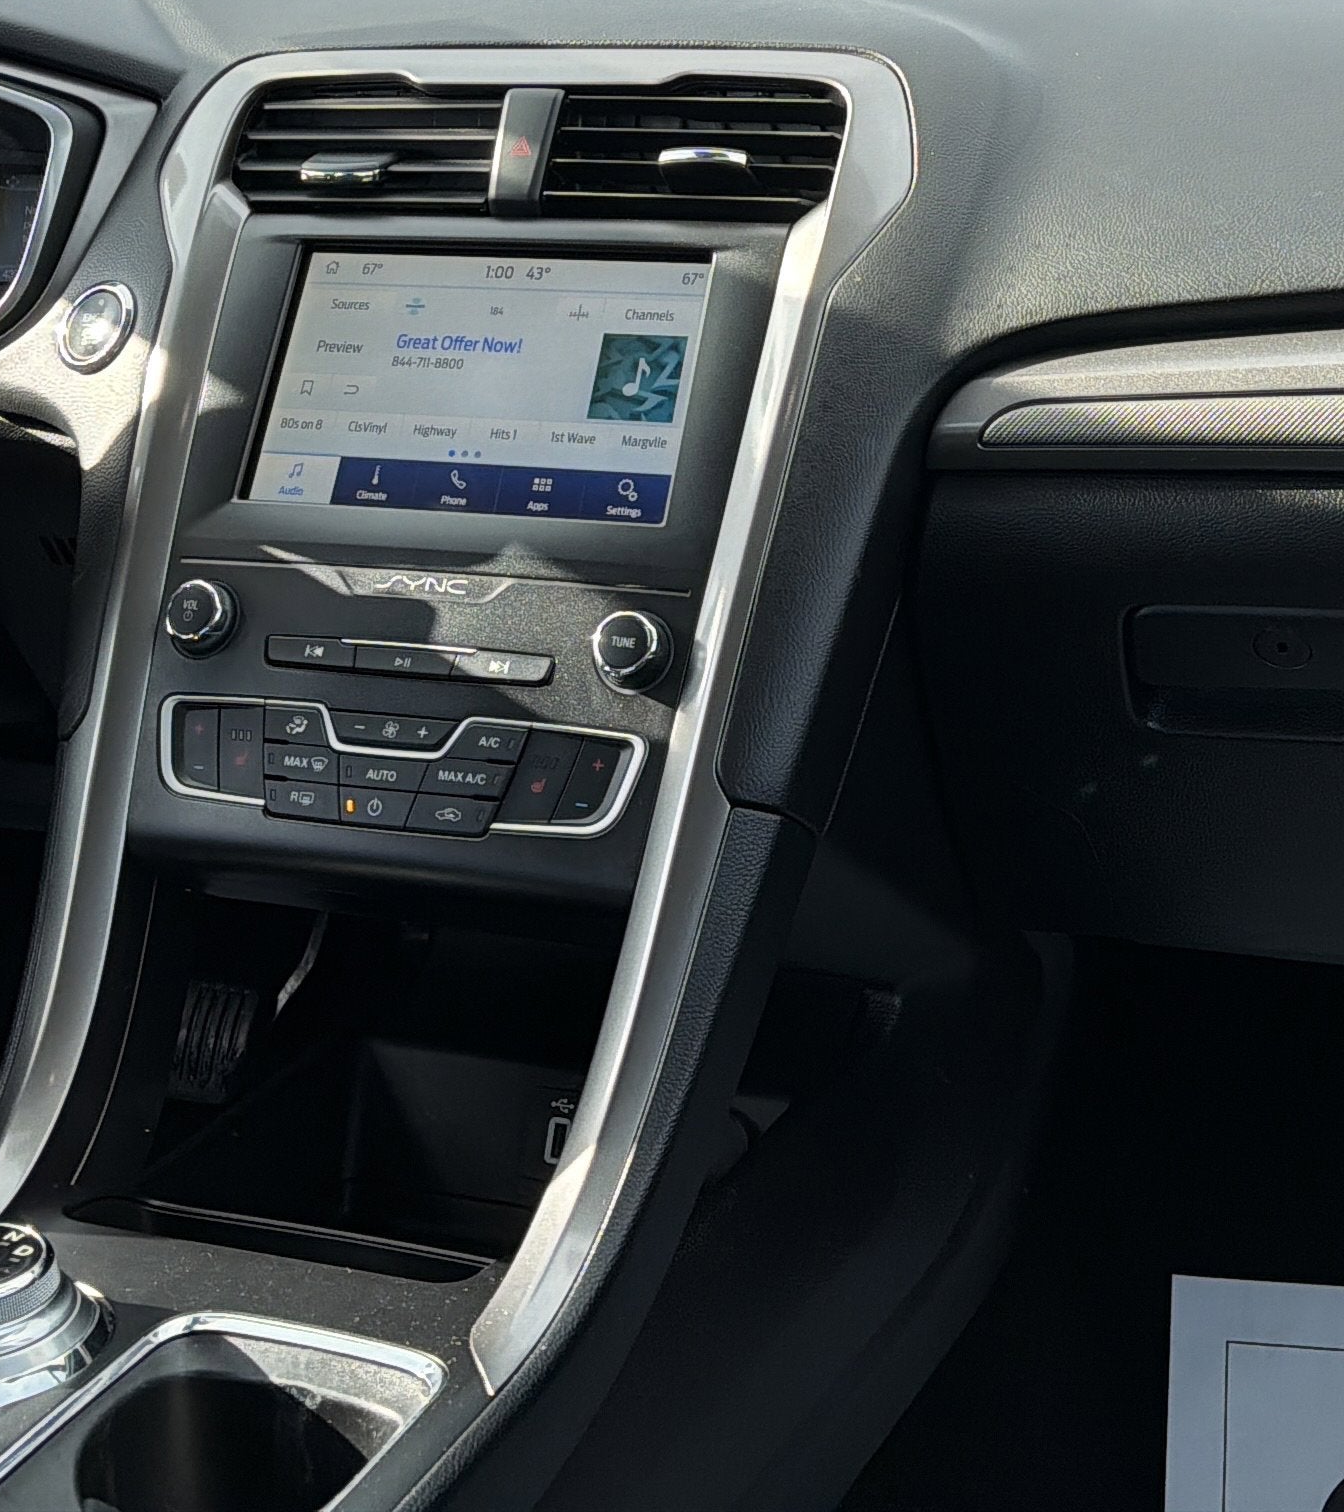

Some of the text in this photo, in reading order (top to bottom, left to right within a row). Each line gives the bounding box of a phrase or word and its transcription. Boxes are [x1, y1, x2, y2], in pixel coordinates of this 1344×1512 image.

[362, 263, 383, 275] 67°
[485, 265, 551, 280] 1:00 43°
[682, 272, 705, 285] 67°
[331, 298, 370, 310] Sources
[625, 308, 674, 322] Channels
[316, 339, 364, 354] Preview
[396, 334, 523, 354] Great Offer Now!
[391, 356, 464, 370] 844-711-8800
[280, 418, 323, 430] 80s on 8
[413, 424, 457, 438] Highway
[490, 428, 510, 440] Hits
[551, 431, 596, 445] 1st Wave
[278, 486, 304, 496] Audio
[356, 490, 387, 502] Climate
[440, 494, 467, 506] Phone
[527, 500, 549, 512] Apps
[606, 505, 642, 518] Settings
[375, 575, 469, 595] SYNC
[182, 598, 199, 610] VOL
[611, 636, 636, 649] TUNE
[478, 735, 501, 749] A/C
[283, 755, 309, 769] MAX
[365, 768, 397, 783] AUTO
[437, 770, 487, 785] MAX A/C
[290, 791, 300, 803] R
[3, 1231, 25, 1242] N
[13, 1244, 34, 1256] D
